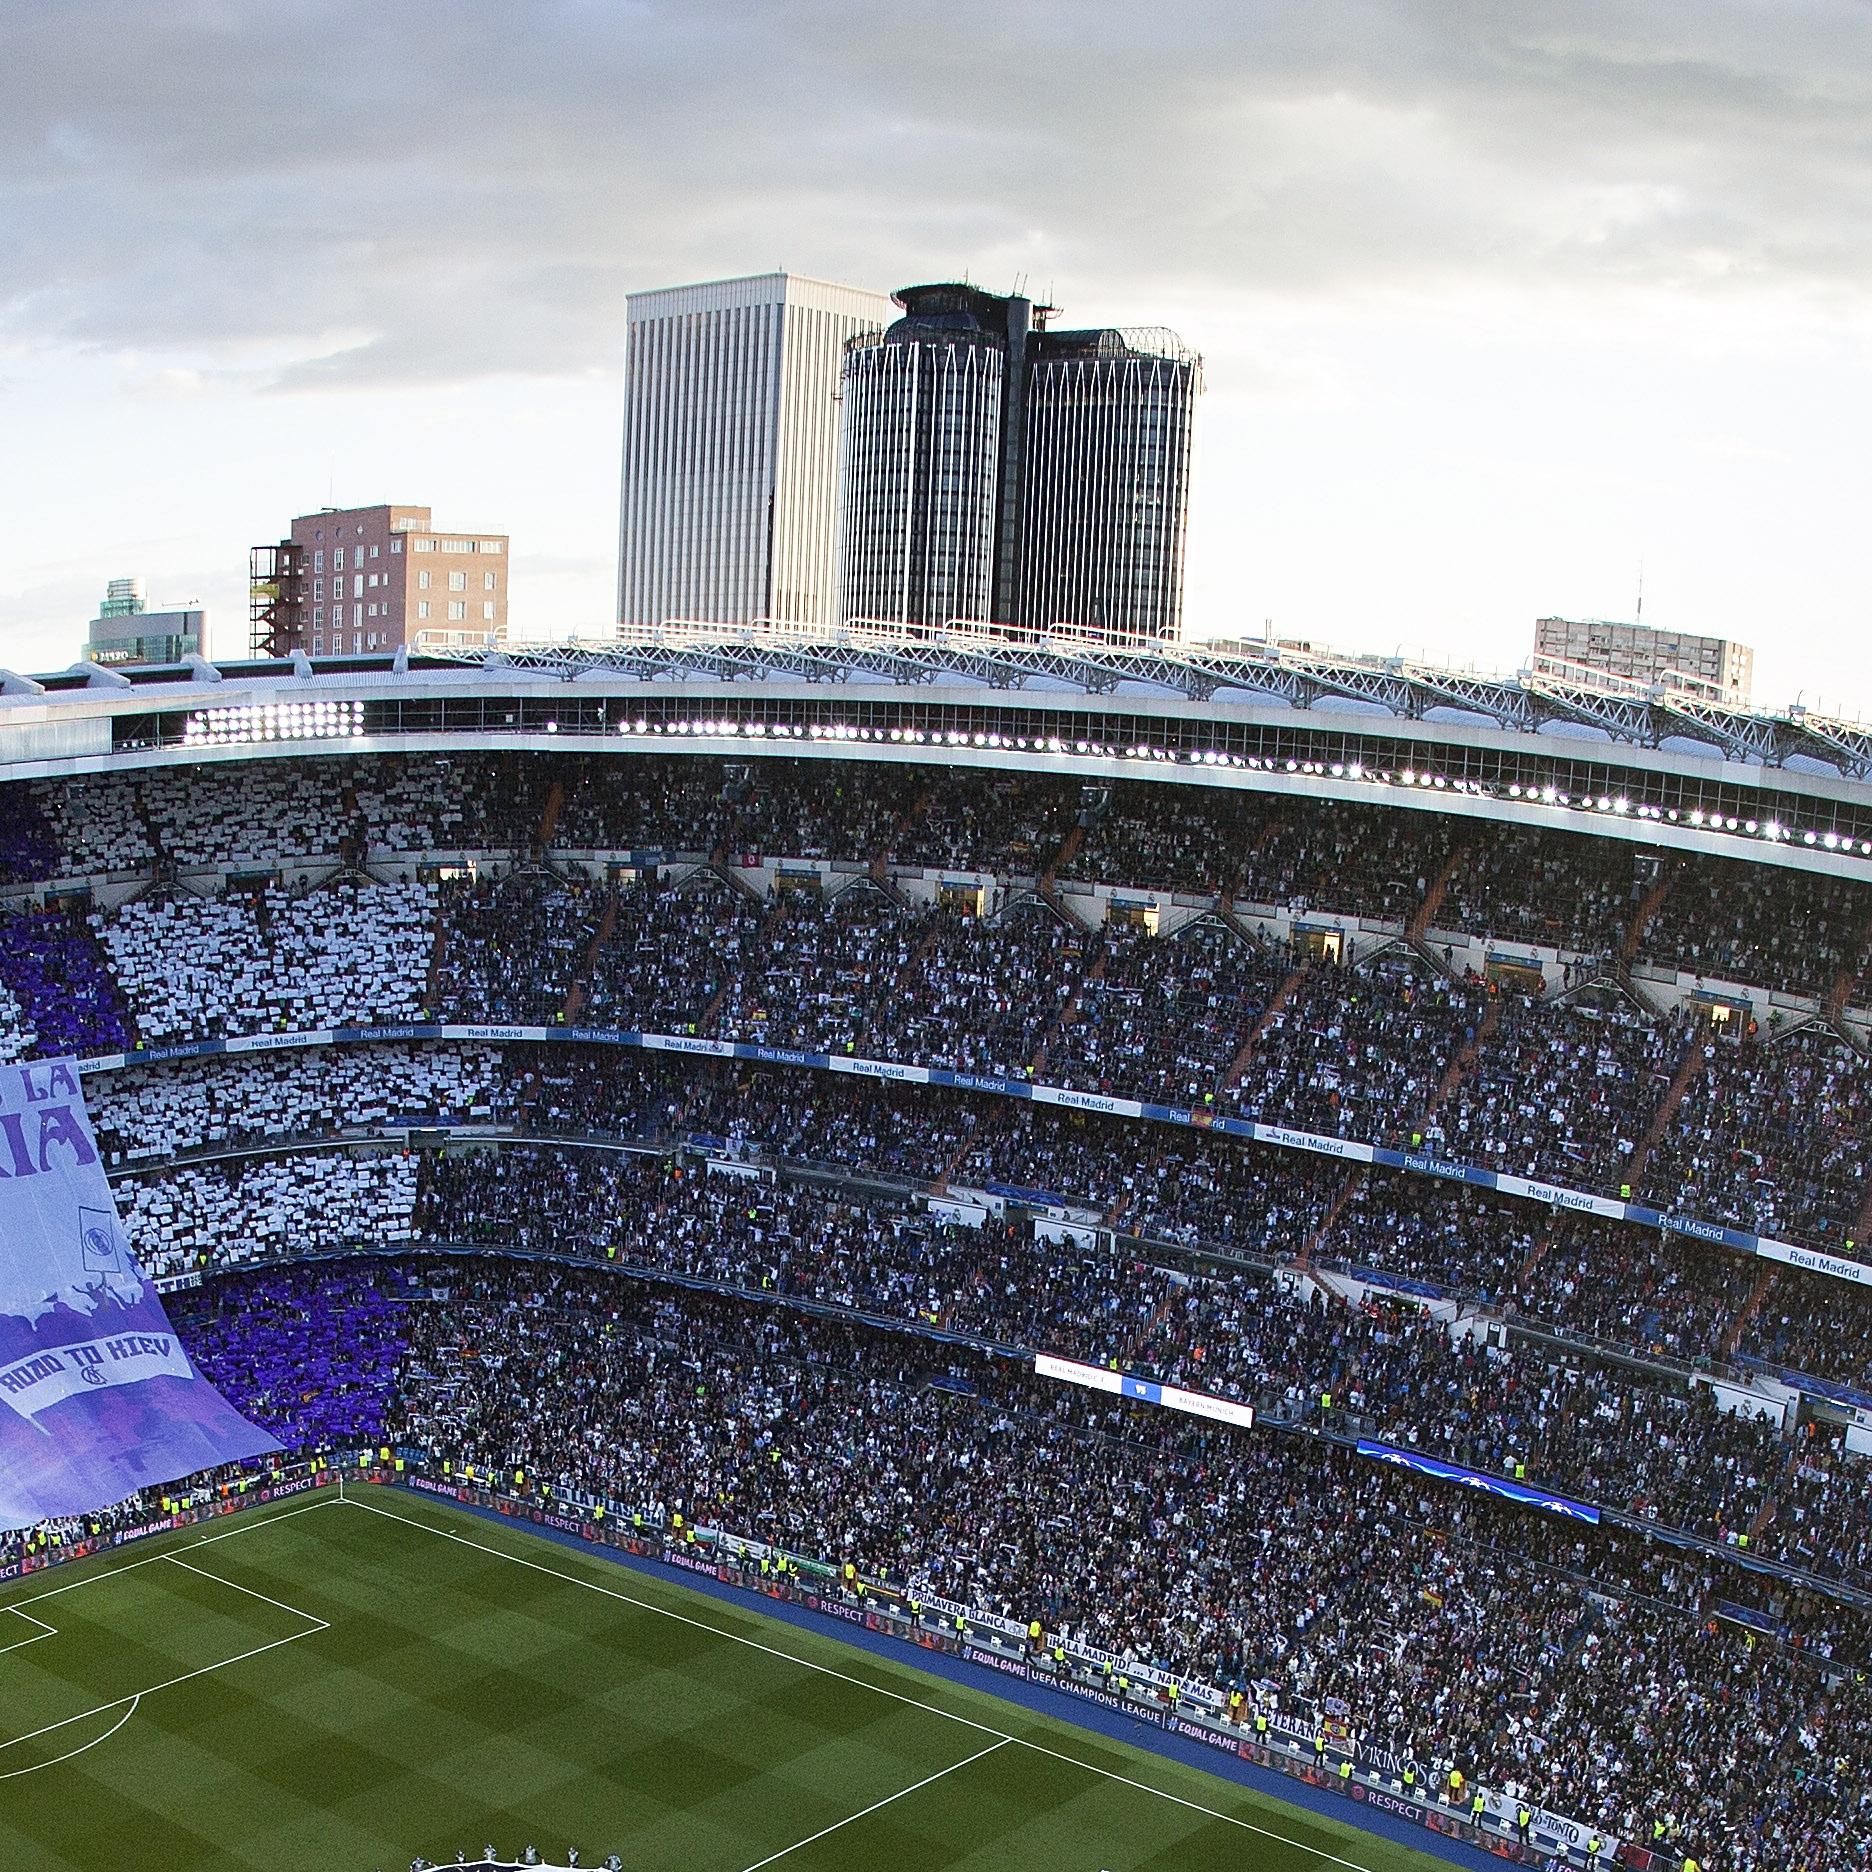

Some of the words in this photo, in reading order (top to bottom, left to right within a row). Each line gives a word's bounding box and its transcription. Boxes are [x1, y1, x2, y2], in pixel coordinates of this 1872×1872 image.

[360, 1028, 381, 1038] Real
[383, 1028, 414, 1038] Madrid
[468, 1029, 488, 1038] Real
[490, 1029, 523, 1038] Madrid
[571, 1030, 590, 1040] Real
[592, 1031, 619, 1041] Madrid
[149, 1047, 168, 1059] Real
[170, 1044, 199, 1057] Madrid
[664, 1040, 682, 1049] Real
[758, 1048, 776, 1060] Real
[777, 1050, 805, 1063] Madrid
[78, 1060, 101, 1072] adrid
[853, 1062, 873, 1073] Real
[873, 1064, 905, 1078] Madrid
[19, 1063, 80, 1104] LA
[954, 1075, 976, 1086] Real
[977, 1078, 1006, 1091] Madrid
[1058, 1092, 1079, 1105] Real
[1081, 1096, 1114, 1111] Madrid
[1169, 1110, 1191, 1123] Real
[1282, 1133, 1305, 1146] Real
[1307, 1137, 1344, 1155] Madrid
[1404, 1156, 1428, 1171] Real
[1429, 1160, 1466, 1179] Madrid
[1529, 1185, 1552, 1200] Real
[1554, 1190, 1594, 1210] Madrid
[1658, 1214, 1683, 1230] Real
[1685, 1219, 1724, 1240] Madrid
[1789, 1250, 1817, 1266] Real
[1818, 1256, 1861, 1279] Madrid
[66, 1344, 107, 1375] TO
[106, 1336, 171, 1361] KIEV
[274, 1478, 313, 1498] RESPECT
[544, 1514, 580, 1533] RESPECT
[821, 1600, 864, 1623] RESPECT
[911, 1590, 967, 1618] PRIMAVERA
[969, 1609, 1007, 1631] BLANCA
[1000, 1660, 1027, 1677] GAME
[1031, 1670, 1058, 1687] UEFA
[1059, 1680, 1120, 1709] CHAMPIONS
[1121, 1701, 1161, 1722] LEAGUE
[1209, 1732, 1239, 1752] GAME
[1367, 1790, 1424, 1821] RESPECT
